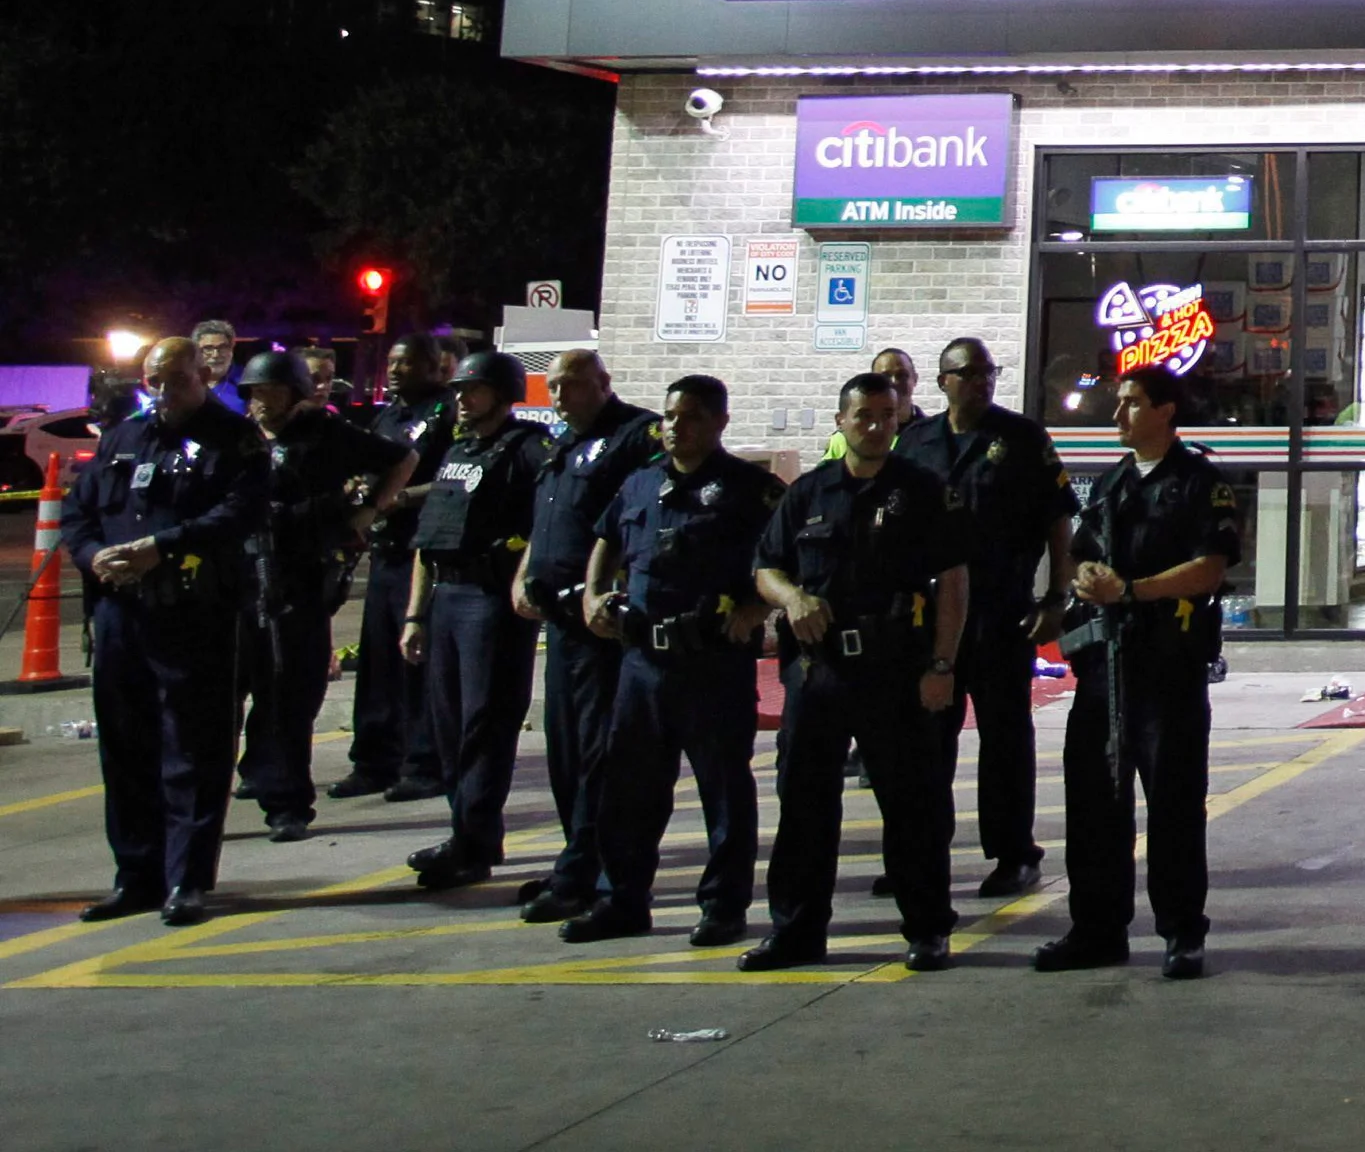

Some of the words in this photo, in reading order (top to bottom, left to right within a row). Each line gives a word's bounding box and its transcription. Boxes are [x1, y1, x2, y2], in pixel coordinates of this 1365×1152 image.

[816, 124, 988, 168] citibank
[841, 201, 889, 221] ATM
[895, 200, 958, 221] Inside
[749, 242, 796, 251] VIOLATION
[822, 251, 868, 261] RESERVED
[755, 264, 787, 281] NO
[825, 264, 863, 274] PARKING
[1173, 301, 1202, 321] HOT
[1121, 311, 1214, 374] PIZZA
